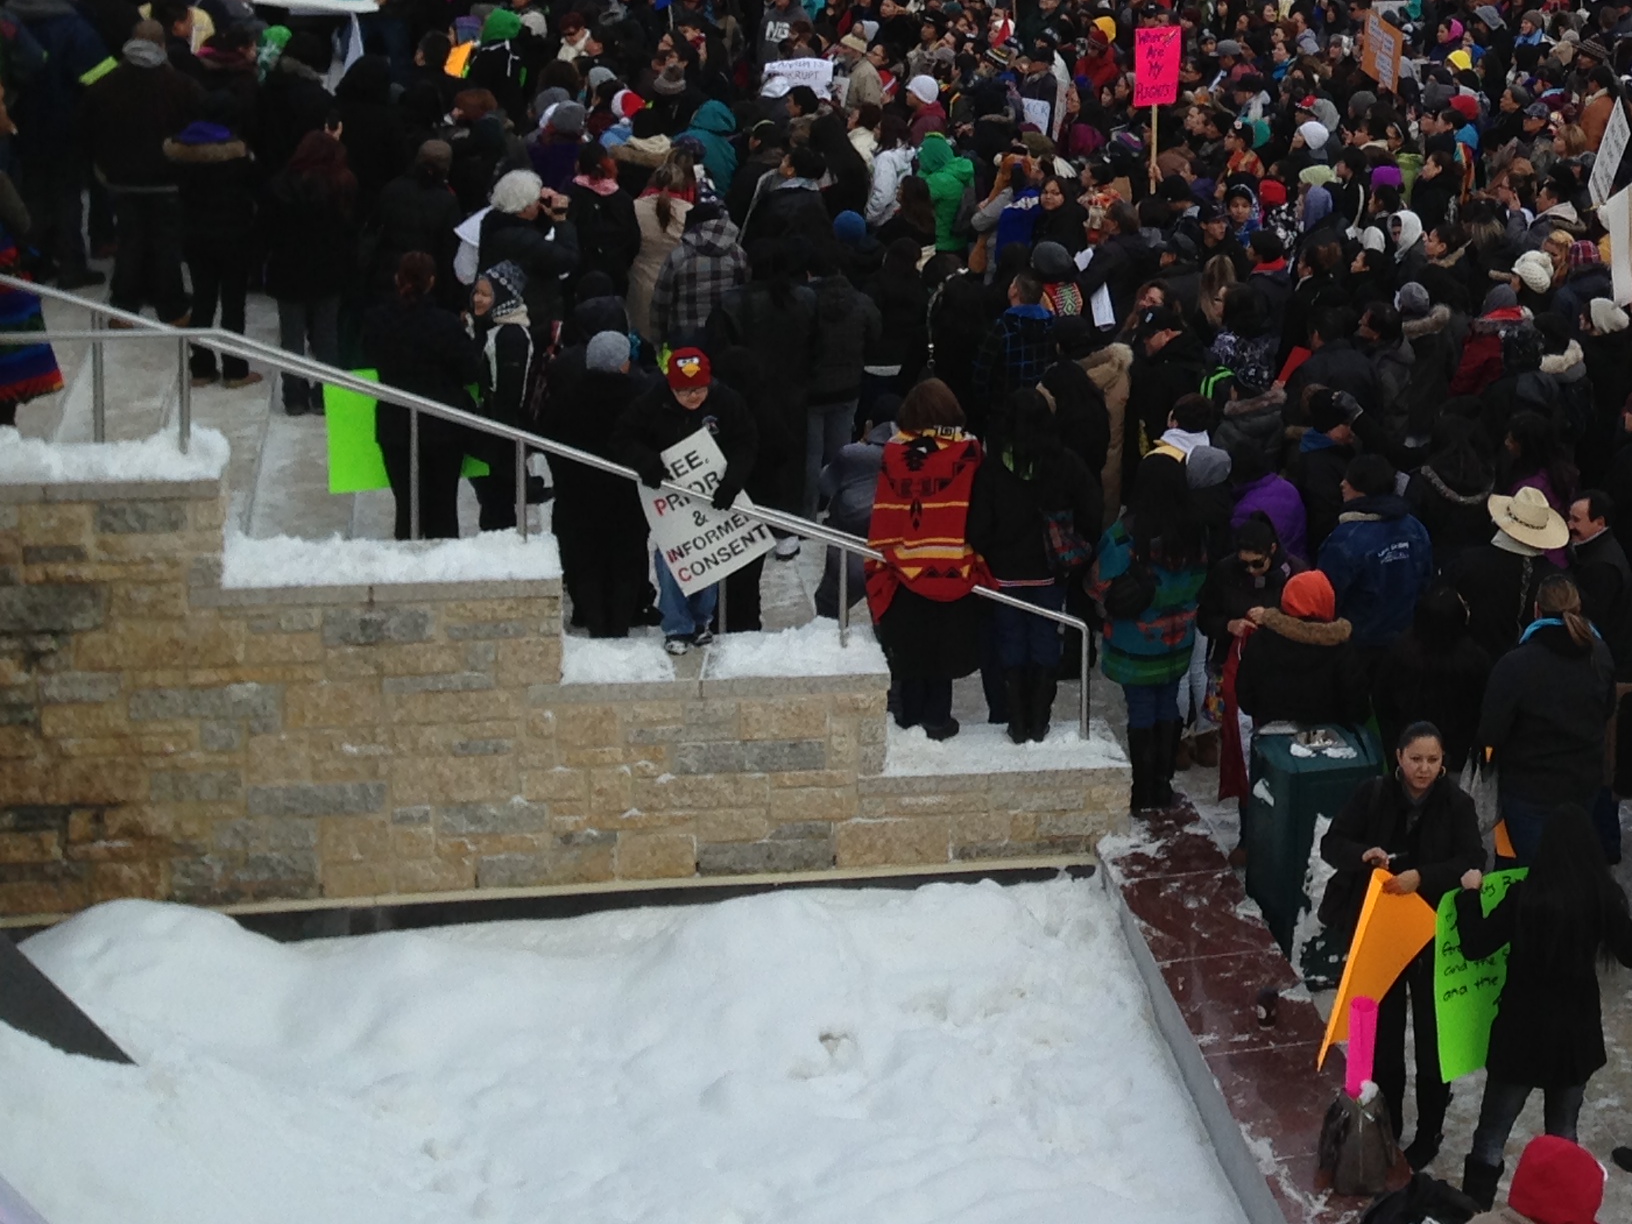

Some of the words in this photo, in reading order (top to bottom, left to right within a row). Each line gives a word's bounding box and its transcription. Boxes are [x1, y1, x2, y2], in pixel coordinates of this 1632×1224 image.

[1146, 45, 1165, 59] Are
[1148, 60, 1163, 80] My
[692, 511, 708, 527] &
[666, 512, 750, 563] INFORME
[677, 525, 767, 582] CONSENT
[1443, 961, 1468, 977] and
[1443, 985, 1468, 1002] and
[1473, 976, 1499, 991] the
